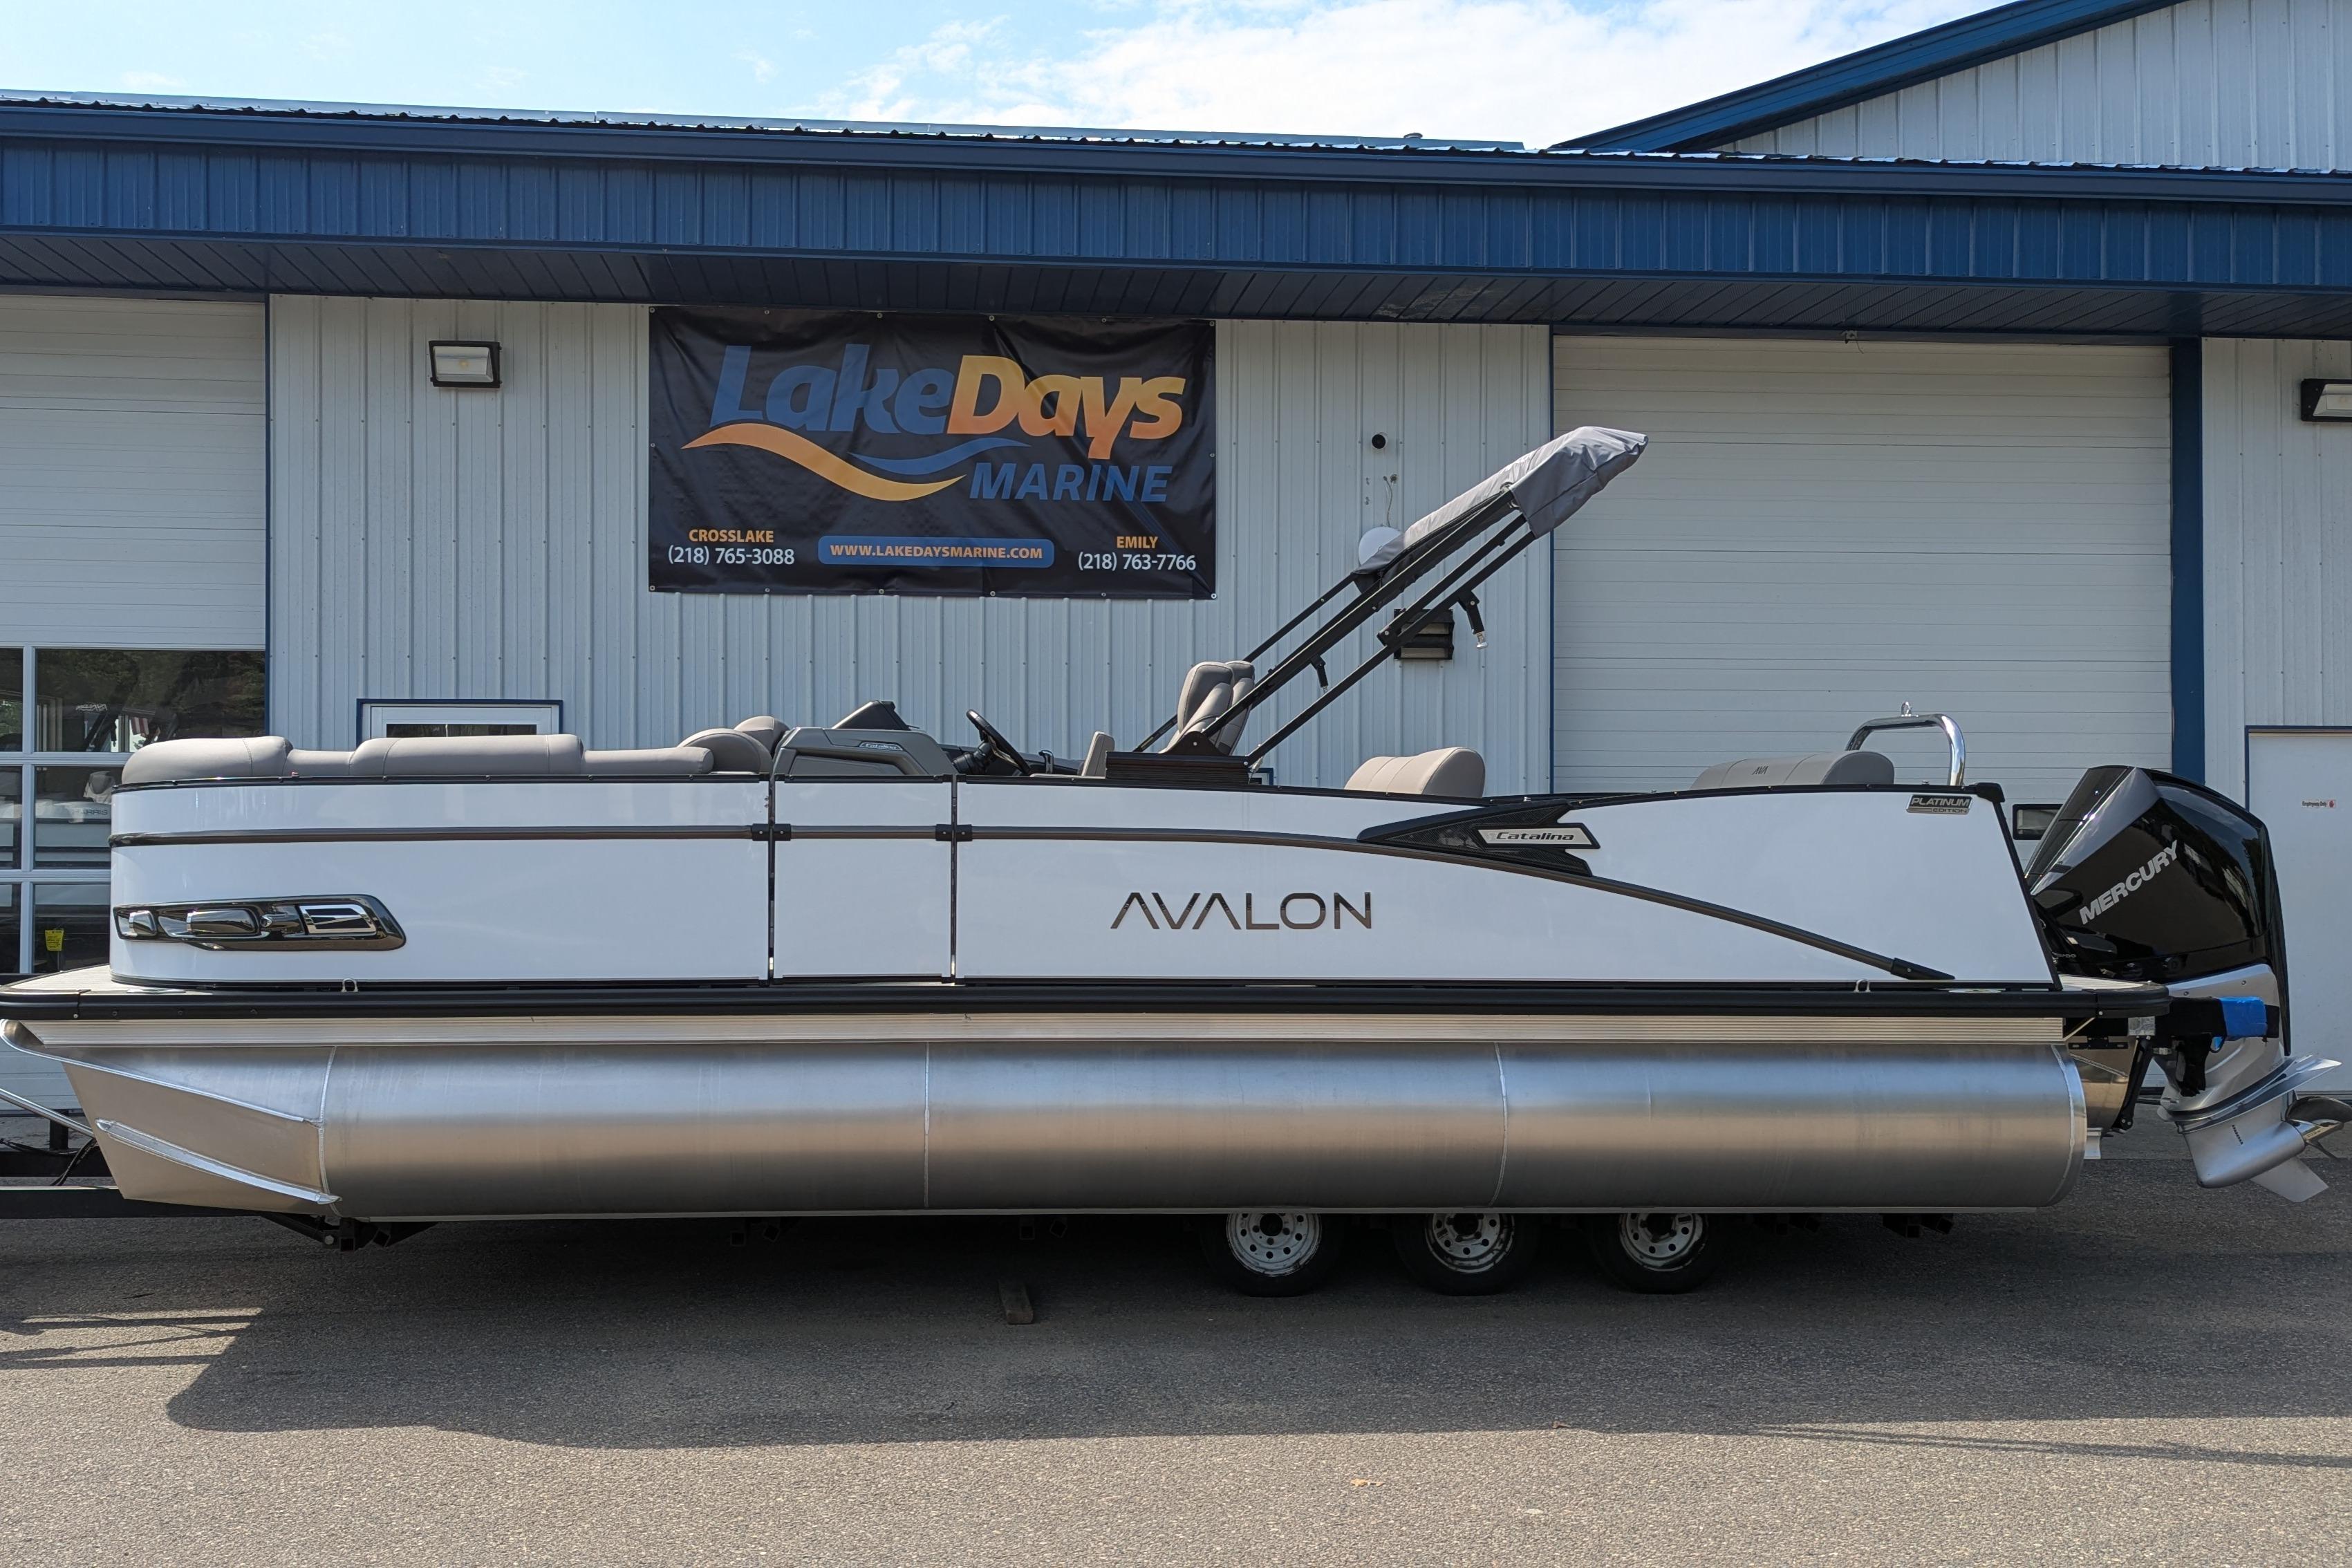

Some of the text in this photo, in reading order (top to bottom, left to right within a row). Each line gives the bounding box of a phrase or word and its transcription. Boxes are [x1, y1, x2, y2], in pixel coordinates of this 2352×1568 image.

[969, 463, 1173, 503] MARINE
[689, 529, 775, 543] CROSSLAKE
[1117, 536, 1159, 549] EMILY
[668, 545, 795, 565] (218) 765-3088
[830, 544, 1043, 559] WWW.LAKEDAYSMARINE.COM
[1079, 552, 1197, 571] (218) 763-7766
[1911, 798, 1970, 806] PLATINUM
[1496, 832, 1574, 841] Catalina
[2079, 839, 2178, 925] MERCURY
[1110, 892, 1372, 930] AVALON
